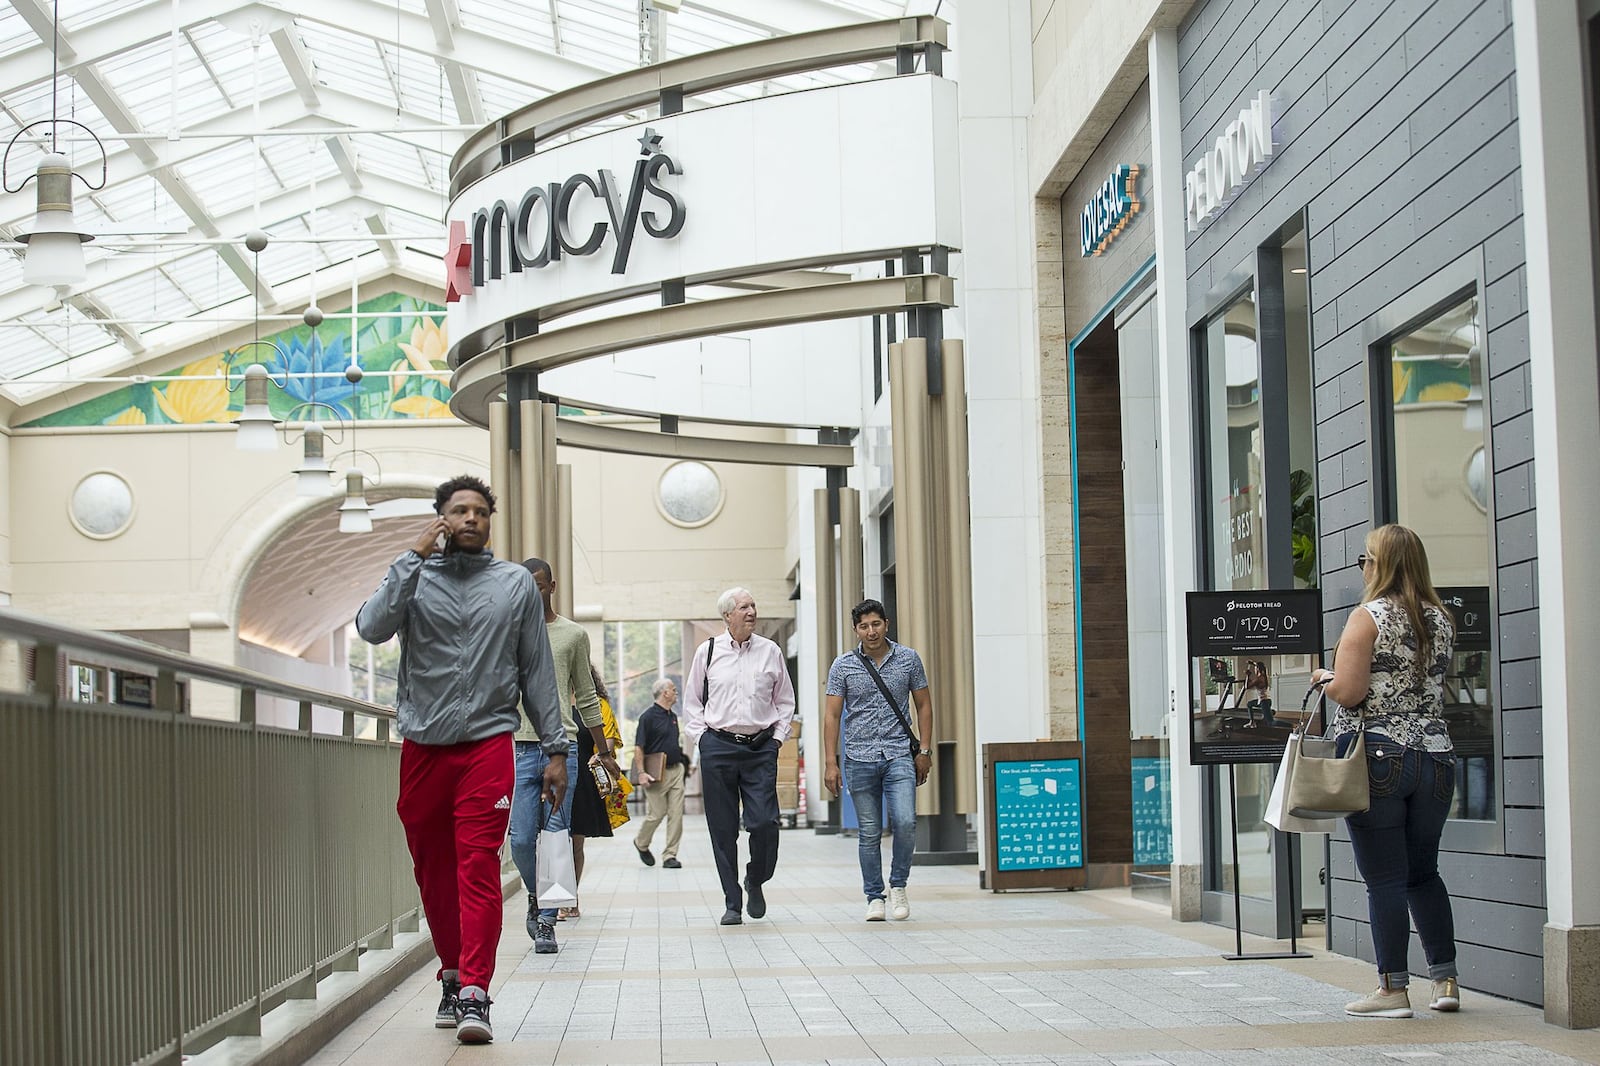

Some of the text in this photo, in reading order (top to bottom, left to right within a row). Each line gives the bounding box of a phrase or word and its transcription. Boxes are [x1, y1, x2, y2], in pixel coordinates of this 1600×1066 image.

[1186, 89, 1273, 232] PELOTON
[1080, 163, 1131, 257] LOVESAC
[1222, 509, 1254, 545] THE BEST
[1225, 549, 1253, 583] CARDIO
[1212, 616, 1226, 631] $0
[1240, 616, 1270, 632] $179
[1283, 615, 1298, 630] 0%
